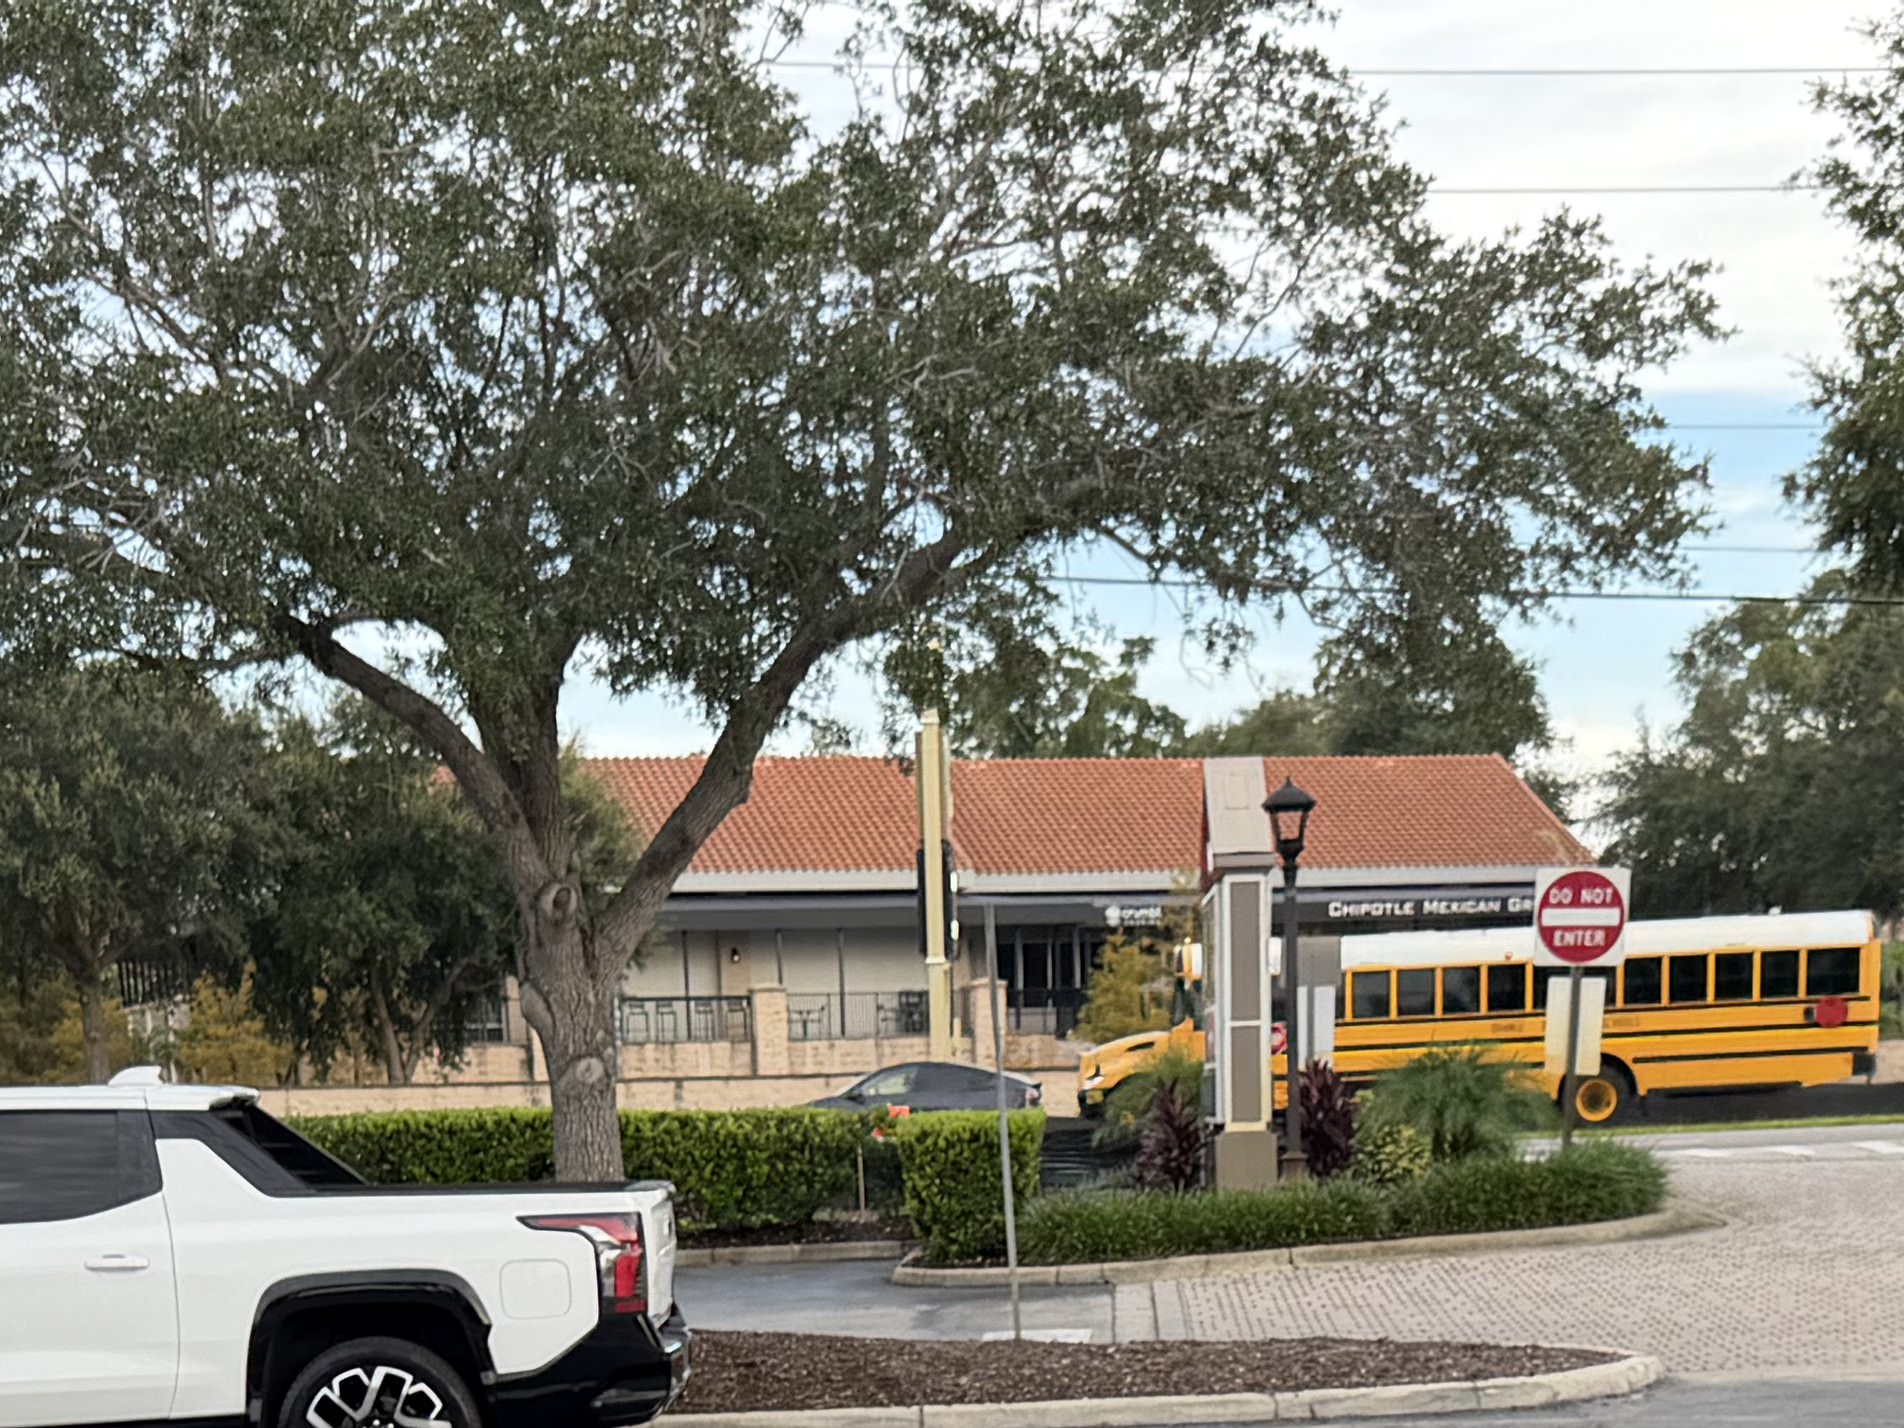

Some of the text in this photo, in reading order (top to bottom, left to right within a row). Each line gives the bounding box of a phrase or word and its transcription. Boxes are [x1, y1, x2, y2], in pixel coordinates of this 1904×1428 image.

[1549, 887, 1613, 904] DO NOT
[1553, 929, 1606, 947] ENTER
